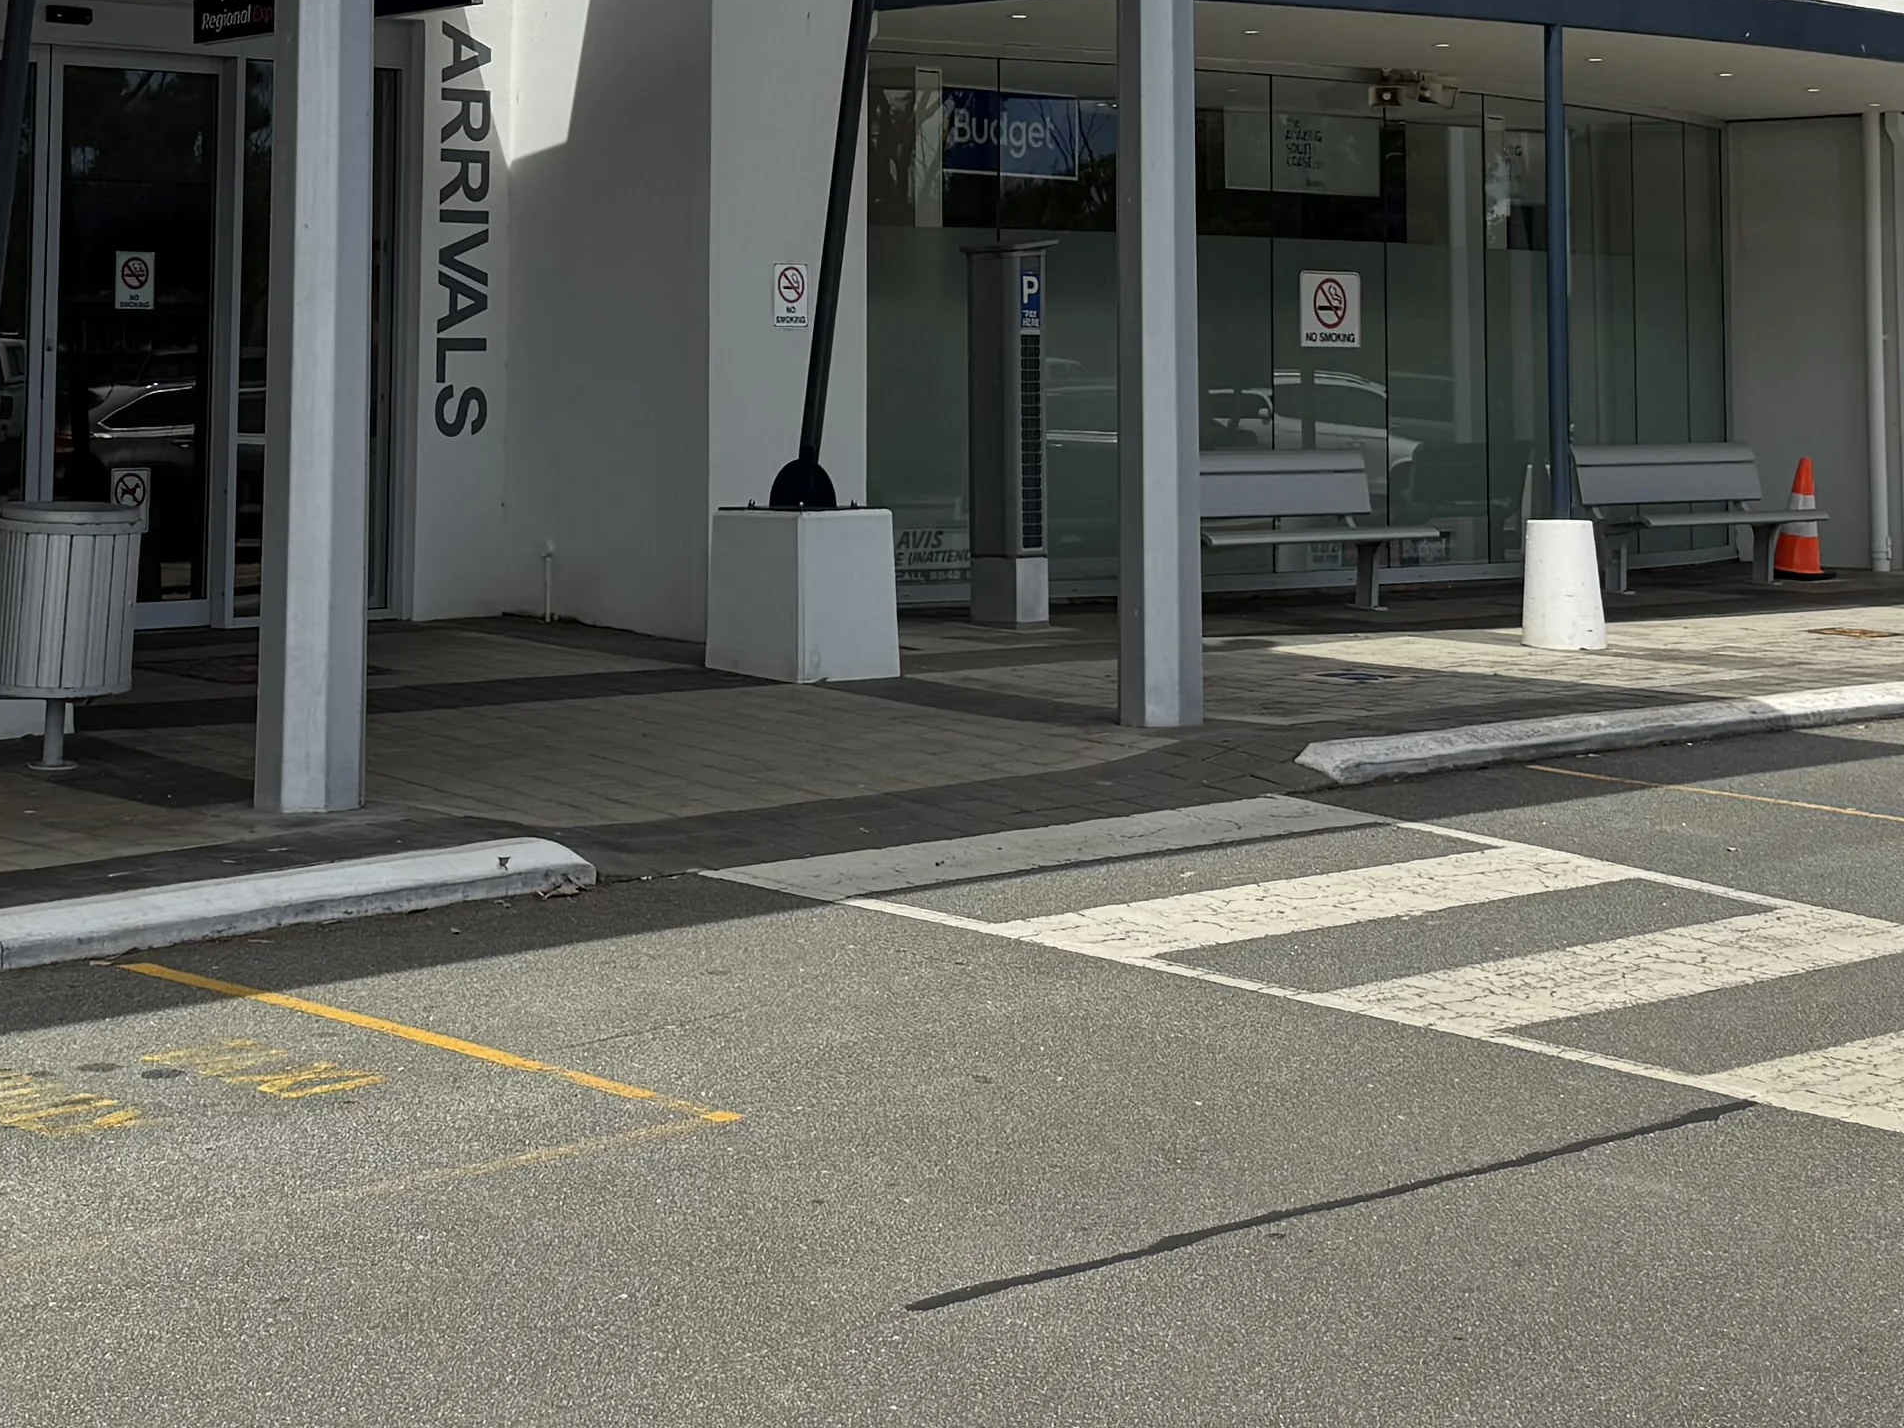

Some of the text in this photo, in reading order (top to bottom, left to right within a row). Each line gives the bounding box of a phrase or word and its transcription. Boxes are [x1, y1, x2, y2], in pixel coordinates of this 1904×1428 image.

[201, 4, 251, 32] Regional
[953, 107, 1056, 159] Budget
[435, 20, 493, 438] ARRIVALS
[1022, 275, 1039, 304] P
[1305, 332, 1355, 343] NO SMOKING
[897, 530, 944, 549] AVIS
